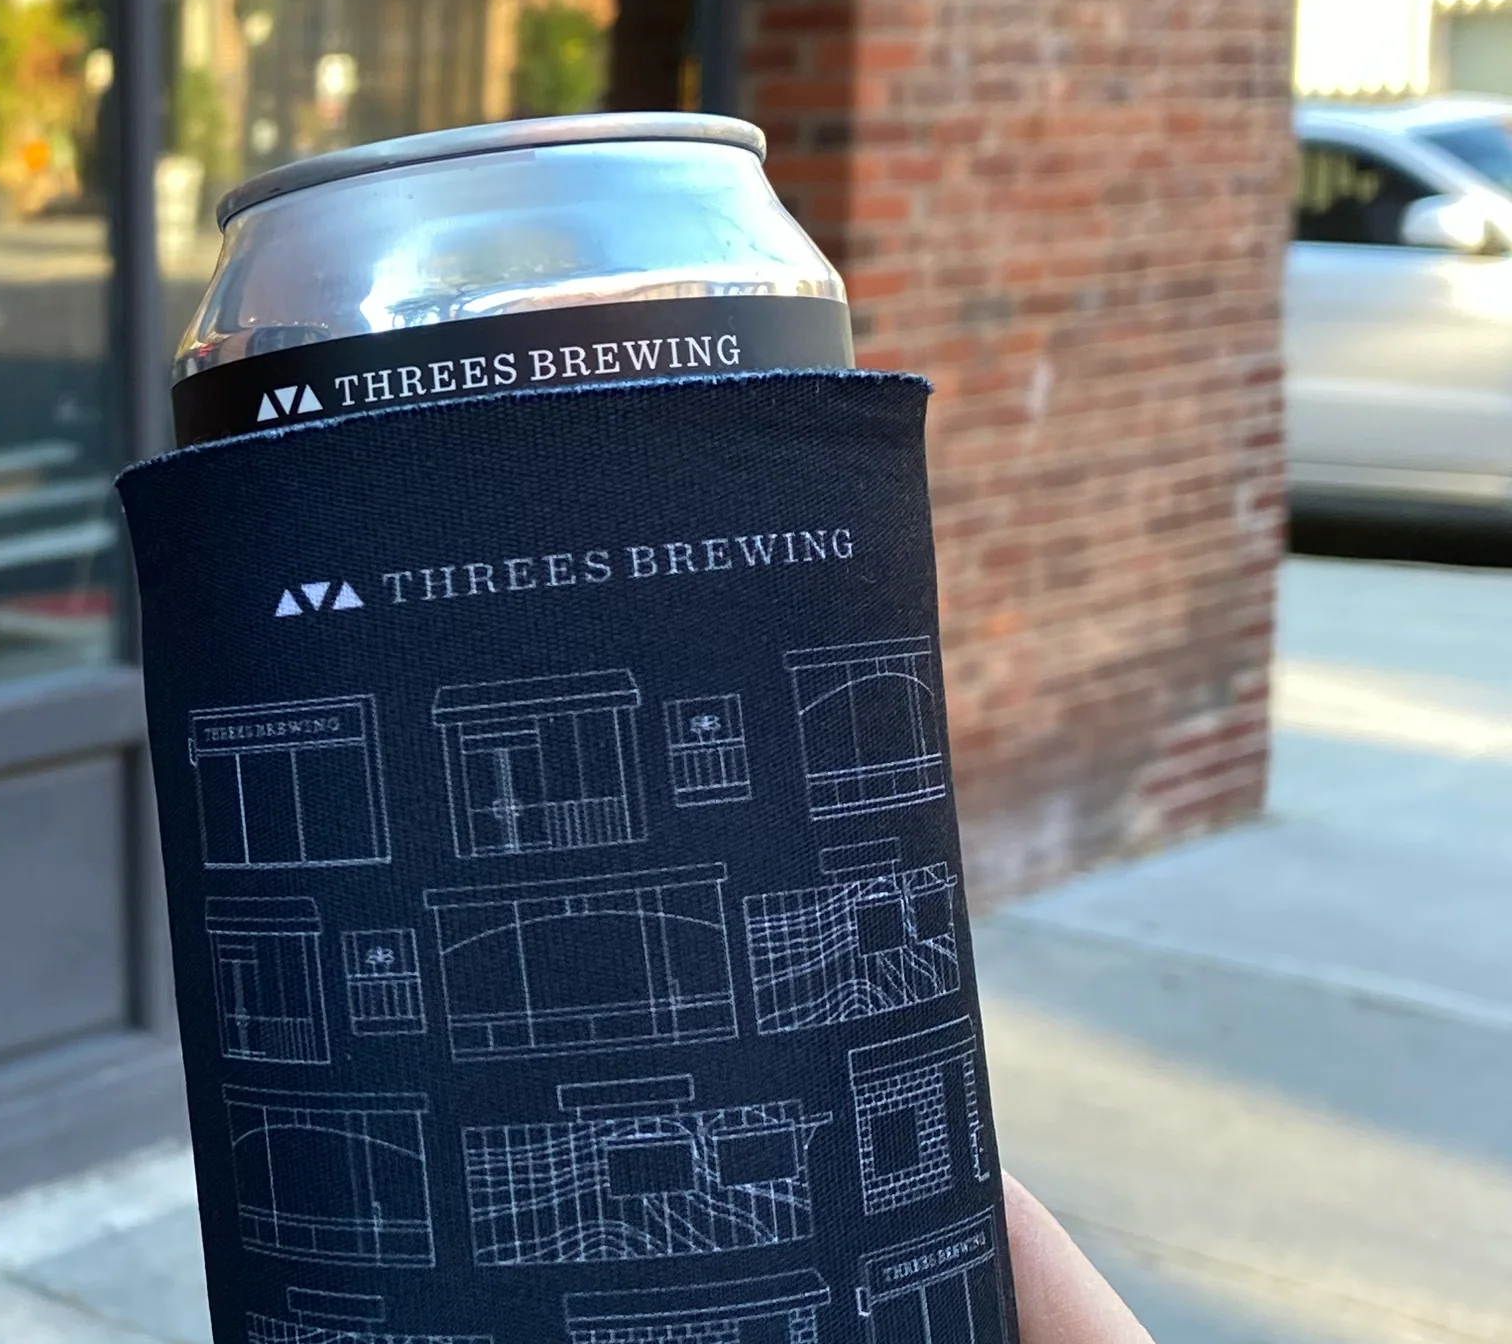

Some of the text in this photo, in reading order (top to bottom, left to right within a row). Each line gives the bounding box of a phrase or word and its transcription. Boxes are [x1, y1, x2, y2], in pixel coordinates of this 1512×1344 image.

[335, 333, 743, 408] THREES BREWING
[382, 529, 855, 604] THREES BREWING
